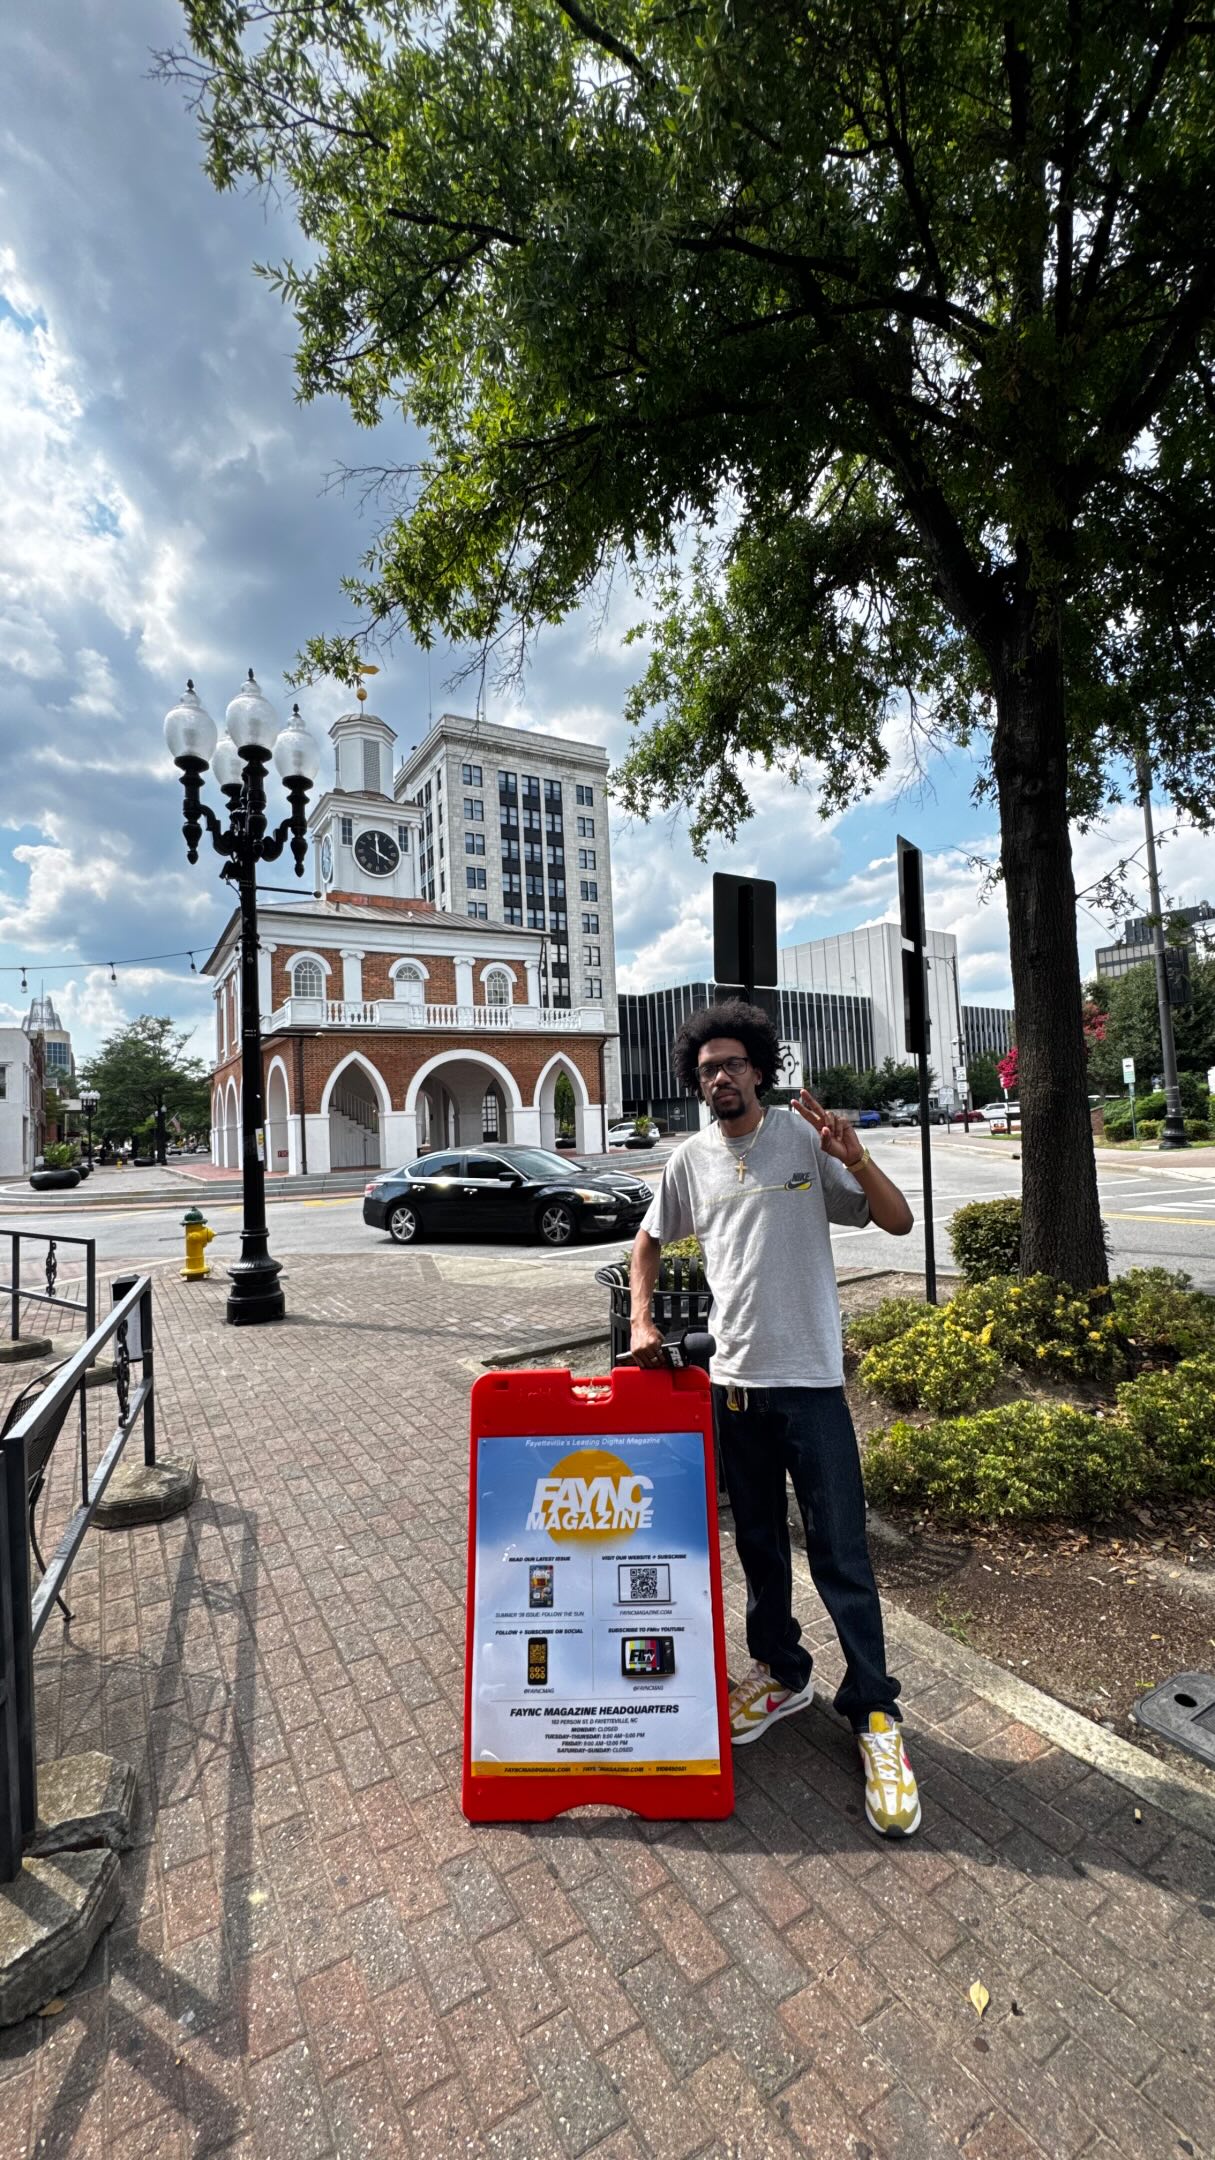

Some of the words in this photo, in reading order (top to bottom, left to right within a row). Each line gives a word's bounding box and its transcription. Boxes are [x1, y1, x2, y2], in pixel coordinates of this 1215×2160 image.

[525, 1439, 570, 1448] Fayetteville's
[572, 1439, 600, 1447] Leading
[602, 1438, 625, 1446] Digital
[626, 1437, 660, 1446] Magazine
[531, 1475, 654, 1513] FAYNC
[525, 1510, 654, 1530] MAGAZINE
[510, 1708, 542, 1716] FAYNC
[544, 1707, 597, 1716] MAGAZINE
[599, 1705, 679, 1715] HEADQUARTERS
